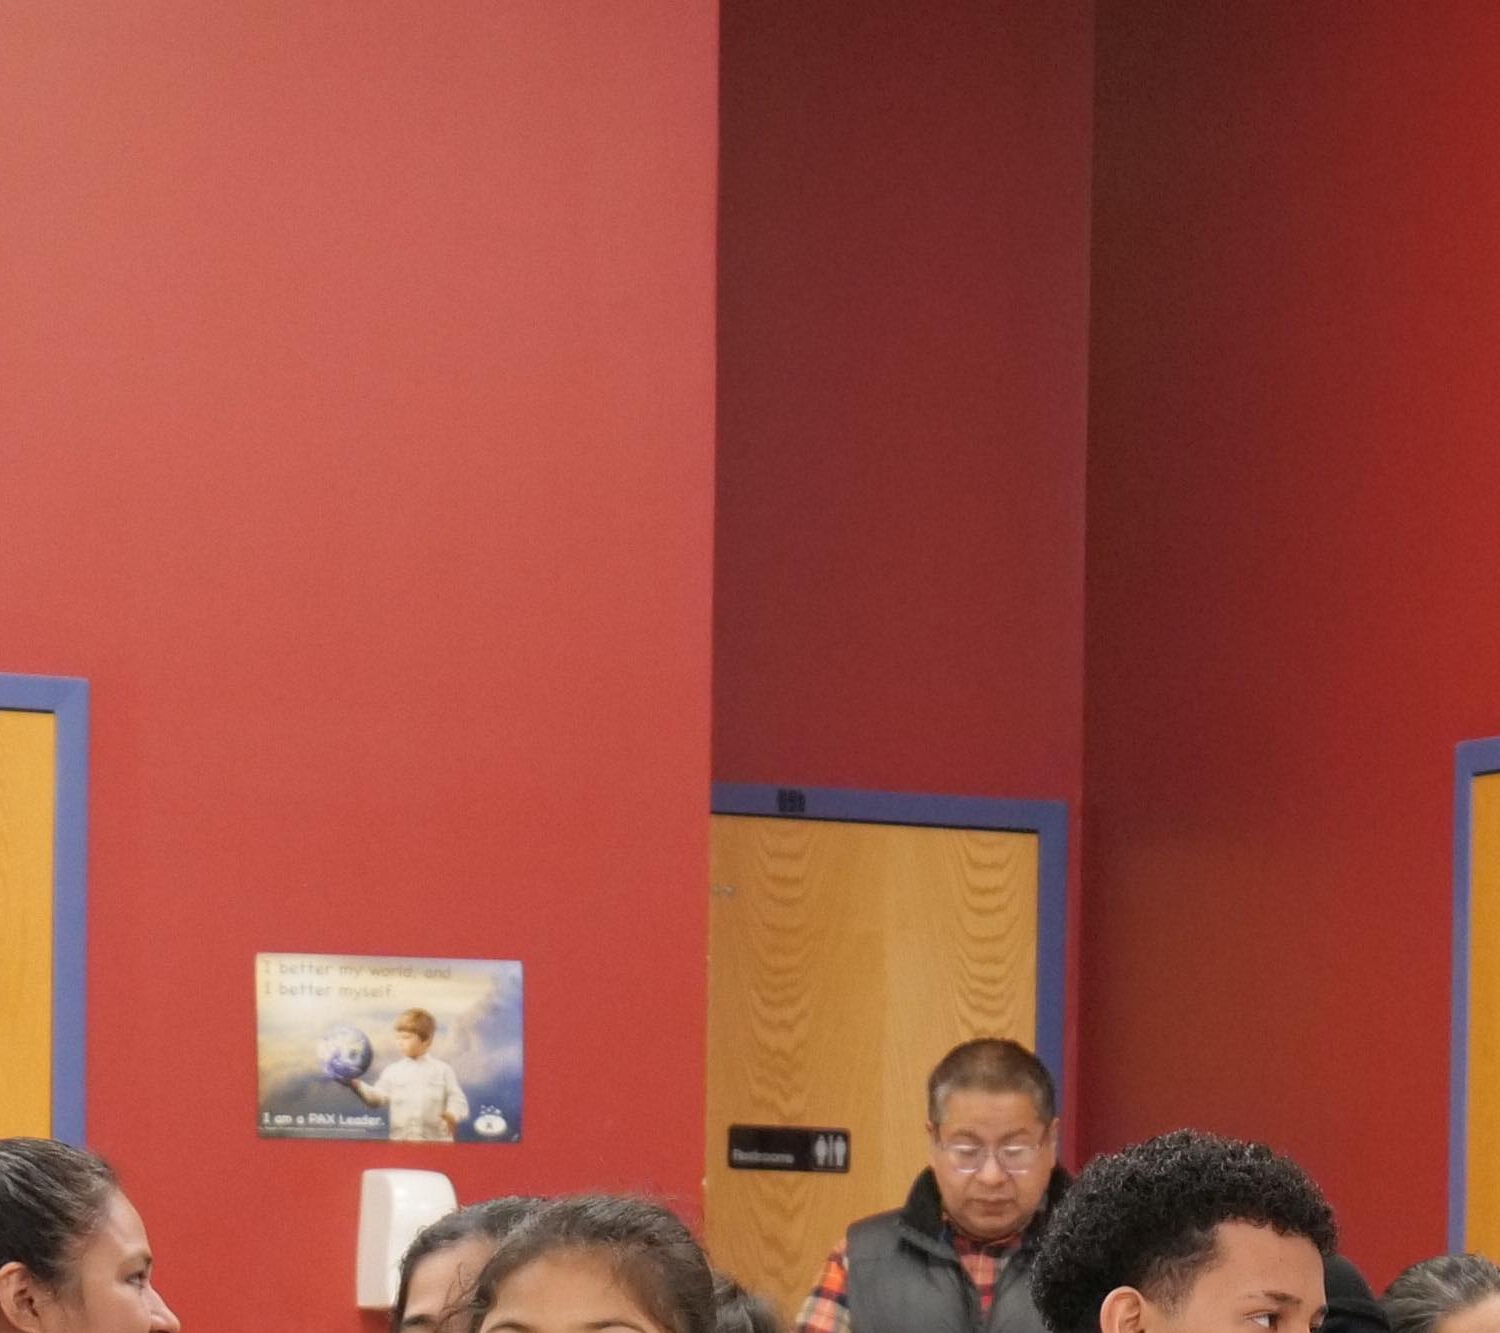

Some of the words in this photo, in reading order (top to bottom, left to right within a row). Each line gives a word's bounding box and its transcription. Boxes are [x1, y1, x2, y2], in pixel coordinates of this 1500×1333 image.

[278, 960, 333, 976] better
[339, 964, 366, 980] my
[424, 965, 450, 980] and
[278, 983, 333, 997] better
